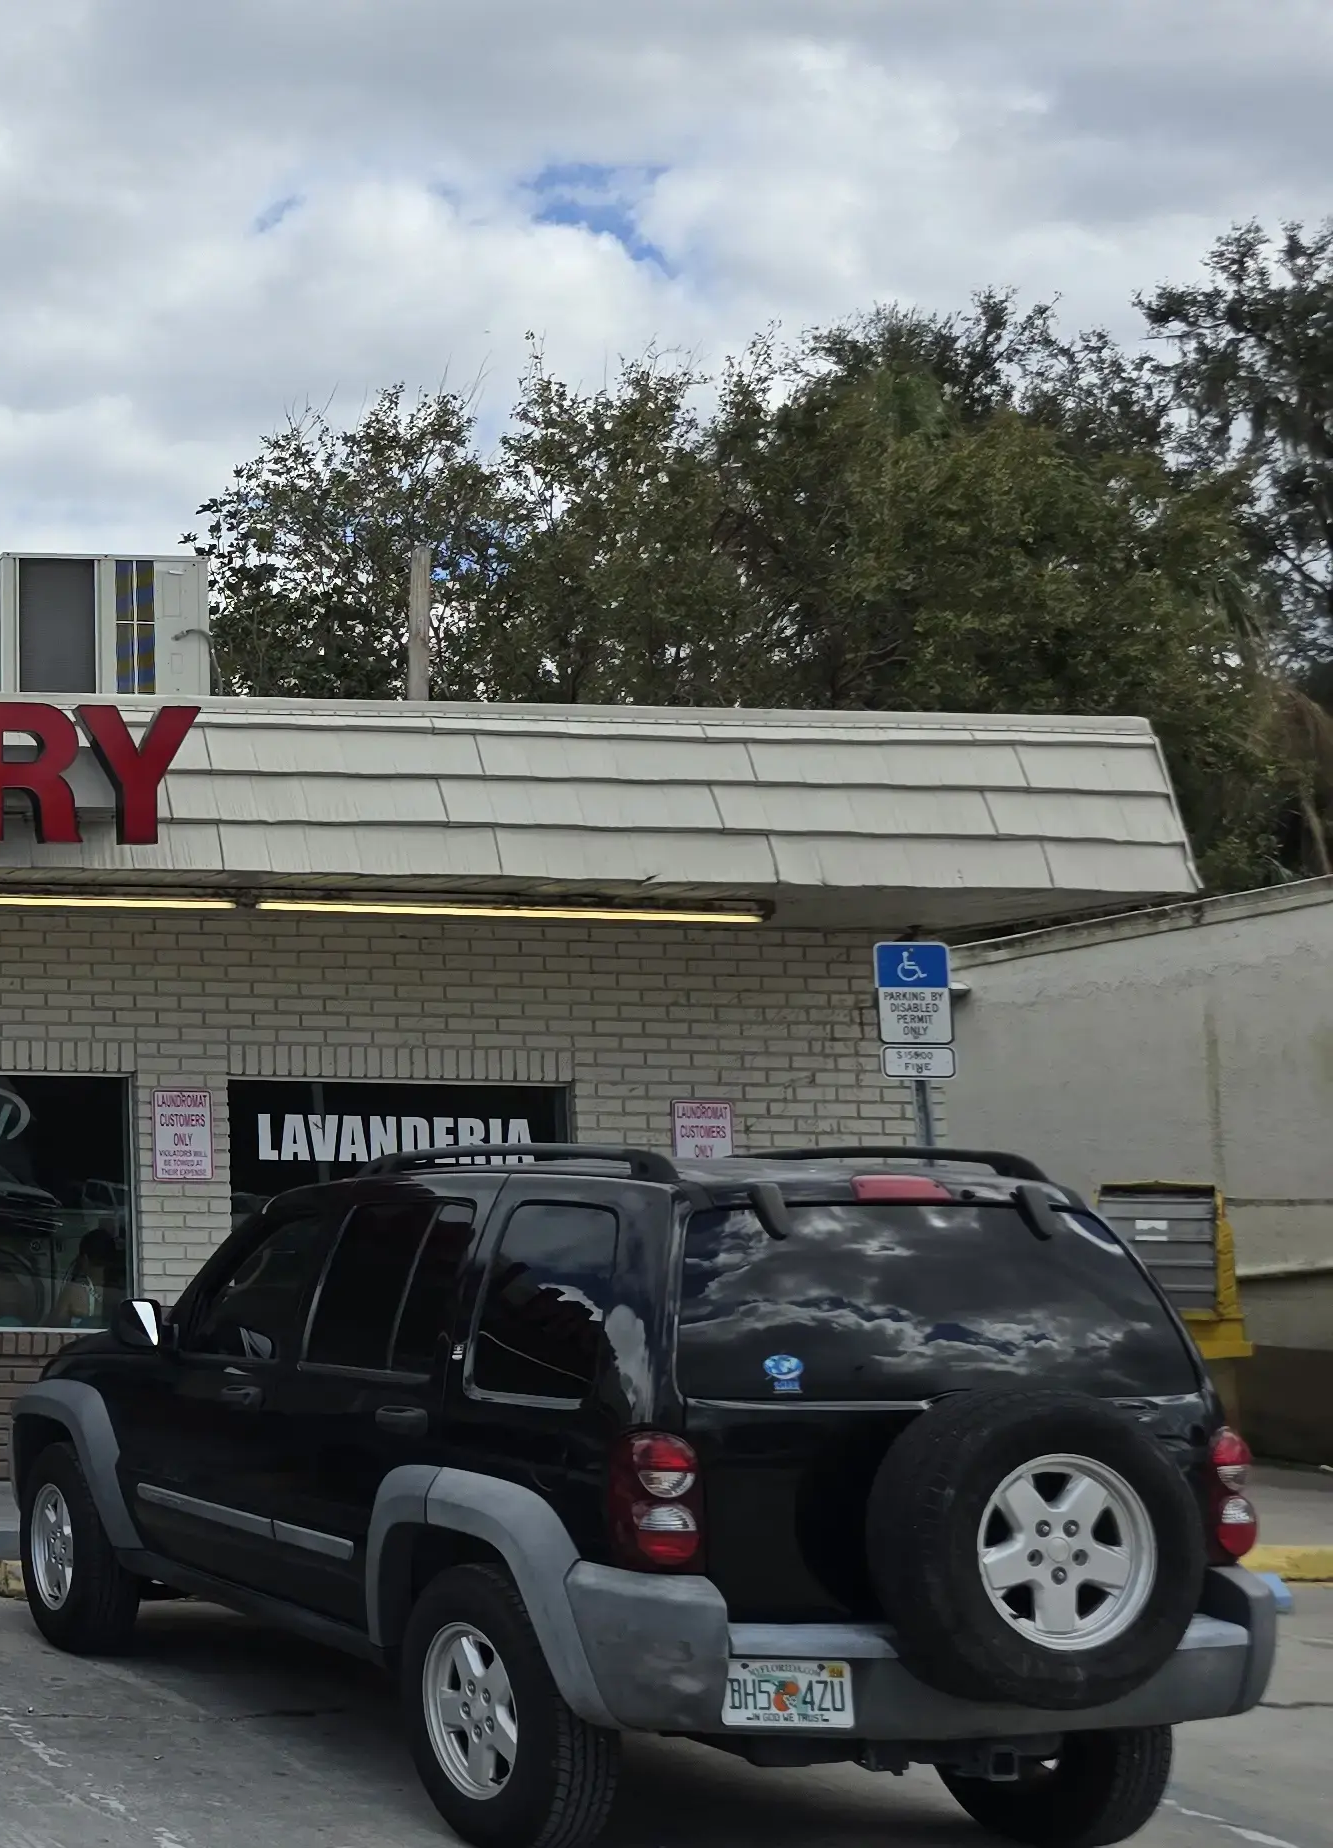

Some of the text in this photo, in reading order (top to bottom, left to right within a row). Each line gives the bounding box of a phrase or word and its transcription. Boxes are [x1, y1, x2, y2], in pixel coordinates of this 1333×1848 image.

[884, 991, 944, 1001] PARKING BY
[890, 1003, 939, 1013] DISABLED
[897, 1014, 933, 1024] PERMIT
[903, 1026, 929, 1036] ONLY
[905, 1062, 932, 1071] FINE
[156, 1094, 207, 1108] LAUNDROMAT
[676, 1105, 728, 1120] LAUNDROMAT
[159, 1113, 206, 1127] CUSTOMERS
[680, 1124, 727, 1139] CUSTOMERS
[173, 1133, 193, 1147] ONLY
[257, 1113, 536, 1165] LAVANDERIA
[694, 1144, 714, 1158] ONLY
[728, 1678, 845, 1711] BH5 4ZU
[762, 1713, 781, 1721] GOD
[783, 1713, 794, 1722] WE
[797, 1713, 824, 1722] TRUST
